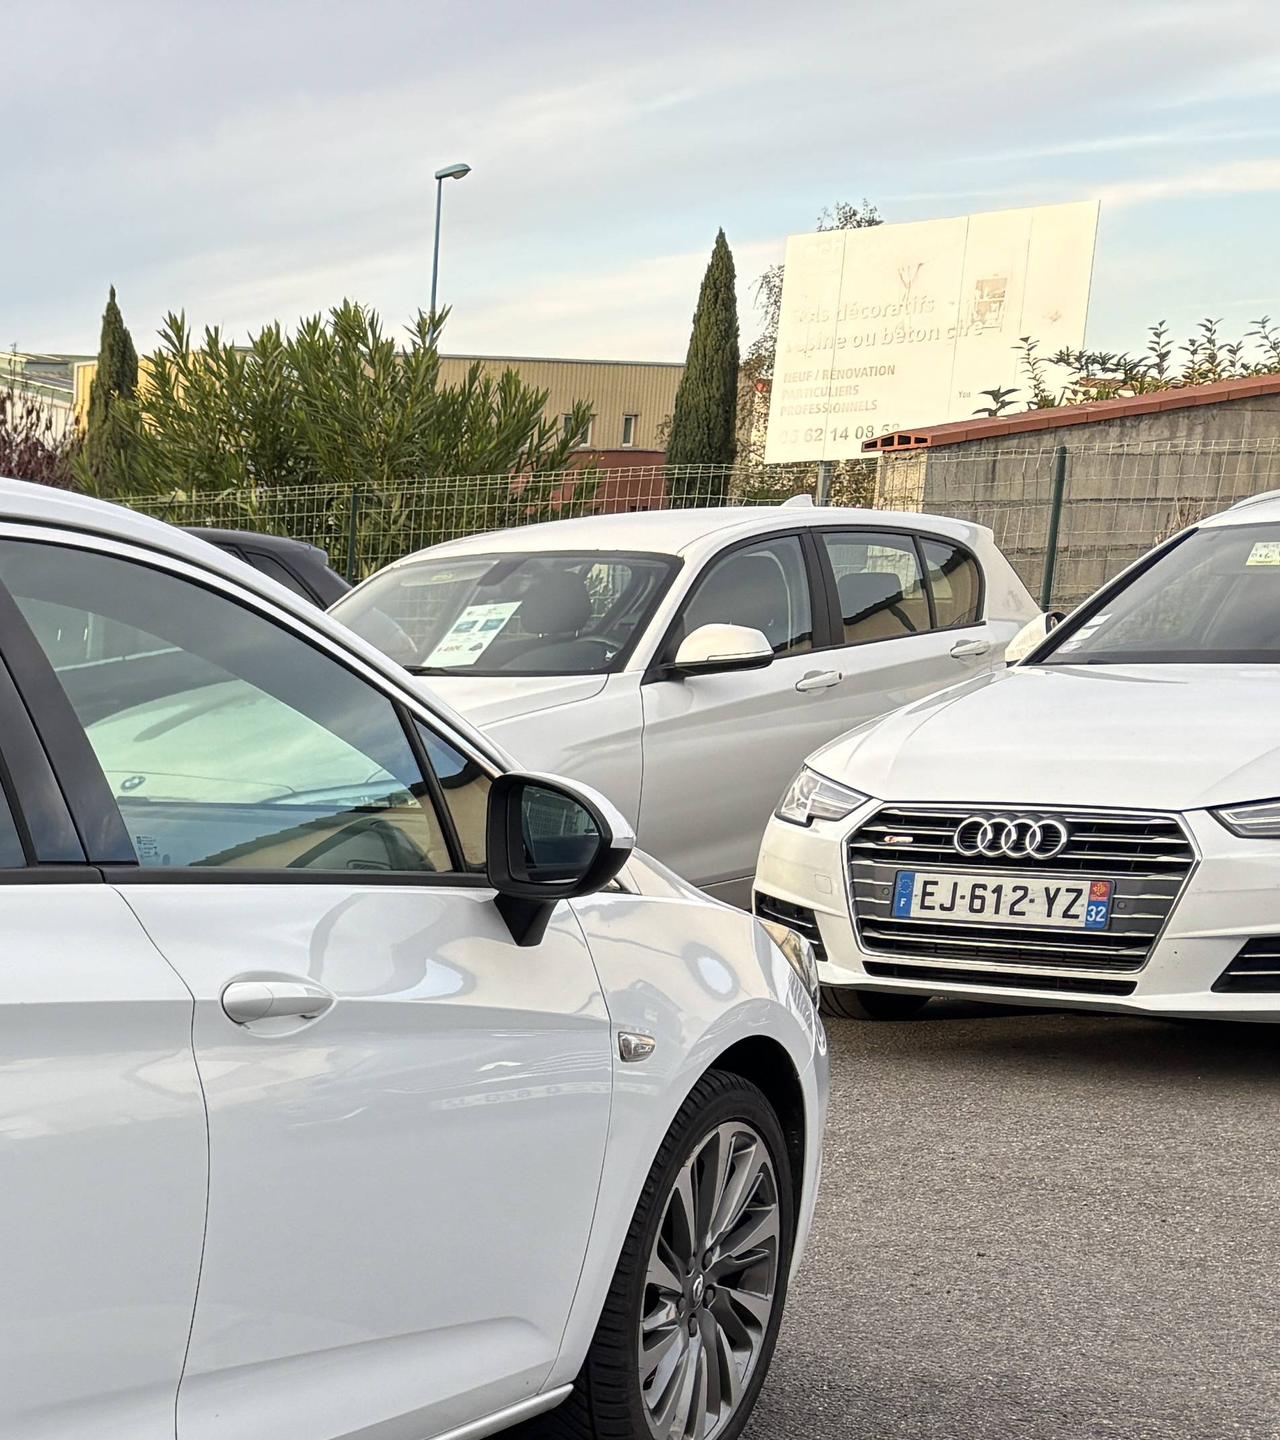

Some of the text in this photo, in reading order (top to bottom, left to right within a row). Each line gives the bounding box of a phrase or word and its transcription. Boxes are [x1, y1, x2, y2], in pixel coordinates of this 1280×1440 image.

[830, 426, 849, 441] 14
[900, 898, 907, 907] F
[1087, 905, 1106, 922] 32
